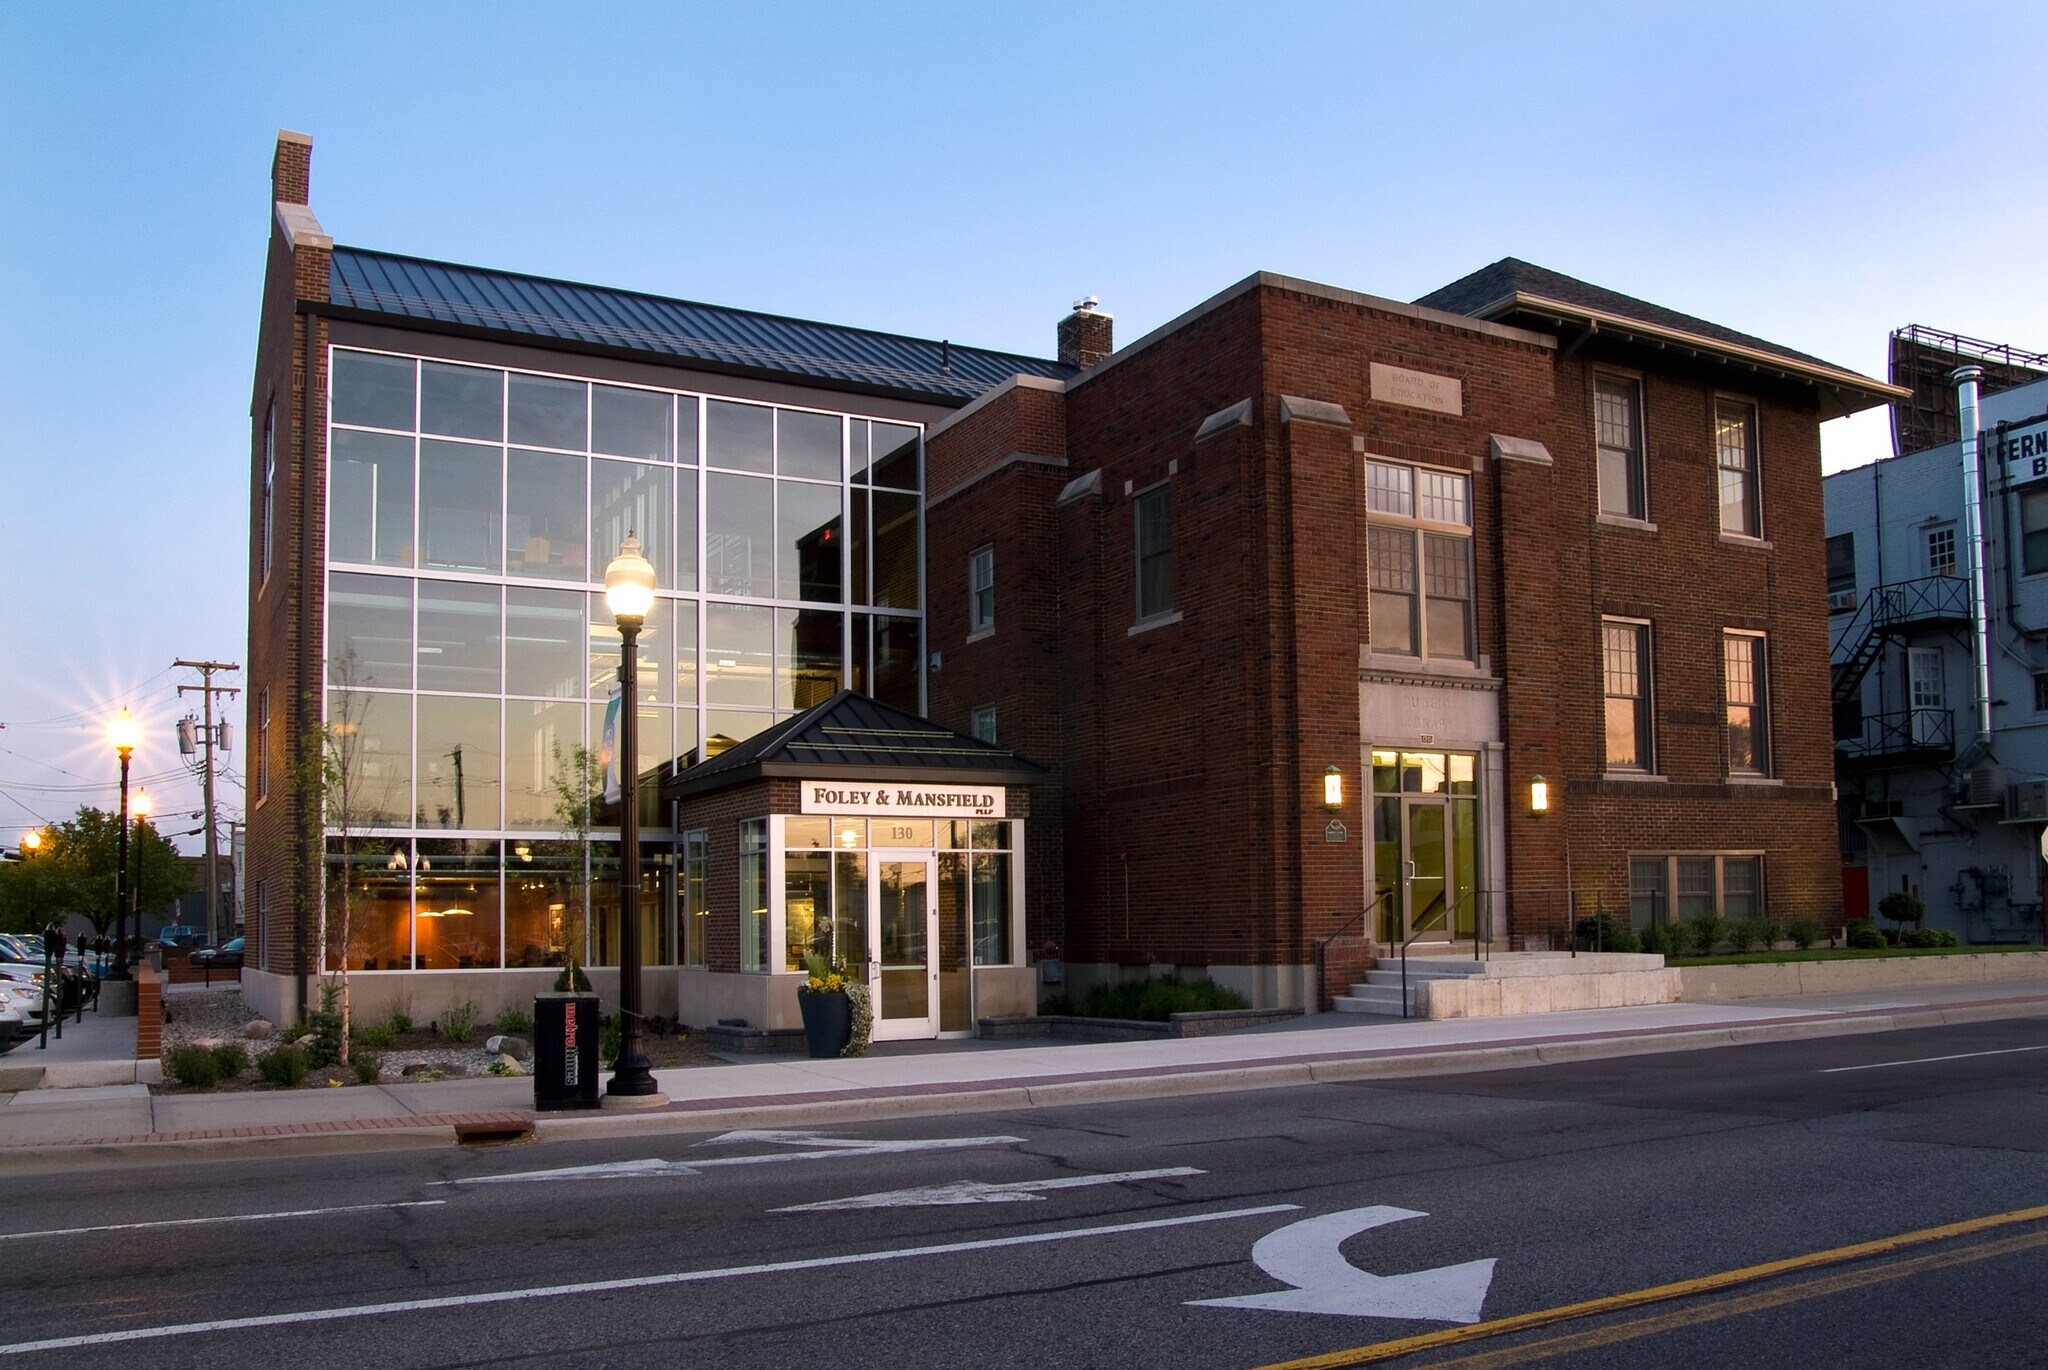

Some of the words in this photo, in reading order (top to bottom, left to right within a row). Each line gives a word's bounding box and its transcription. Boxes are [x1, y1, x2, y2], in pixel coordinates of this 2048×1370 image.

[1391, 373, 1424, 387] BOARD
[1429, 380, 1440, 390] OF
[1390, 387, 1443, 405] EDUCATION
[814, 788, 871, 805] FOLEY
[875, 790, 890, 805] &
[896, 790, 995, 808] MANSFIELD
[891, 827, 913, 840] 130
[565, 1002, 578, 1086] metrotimes
